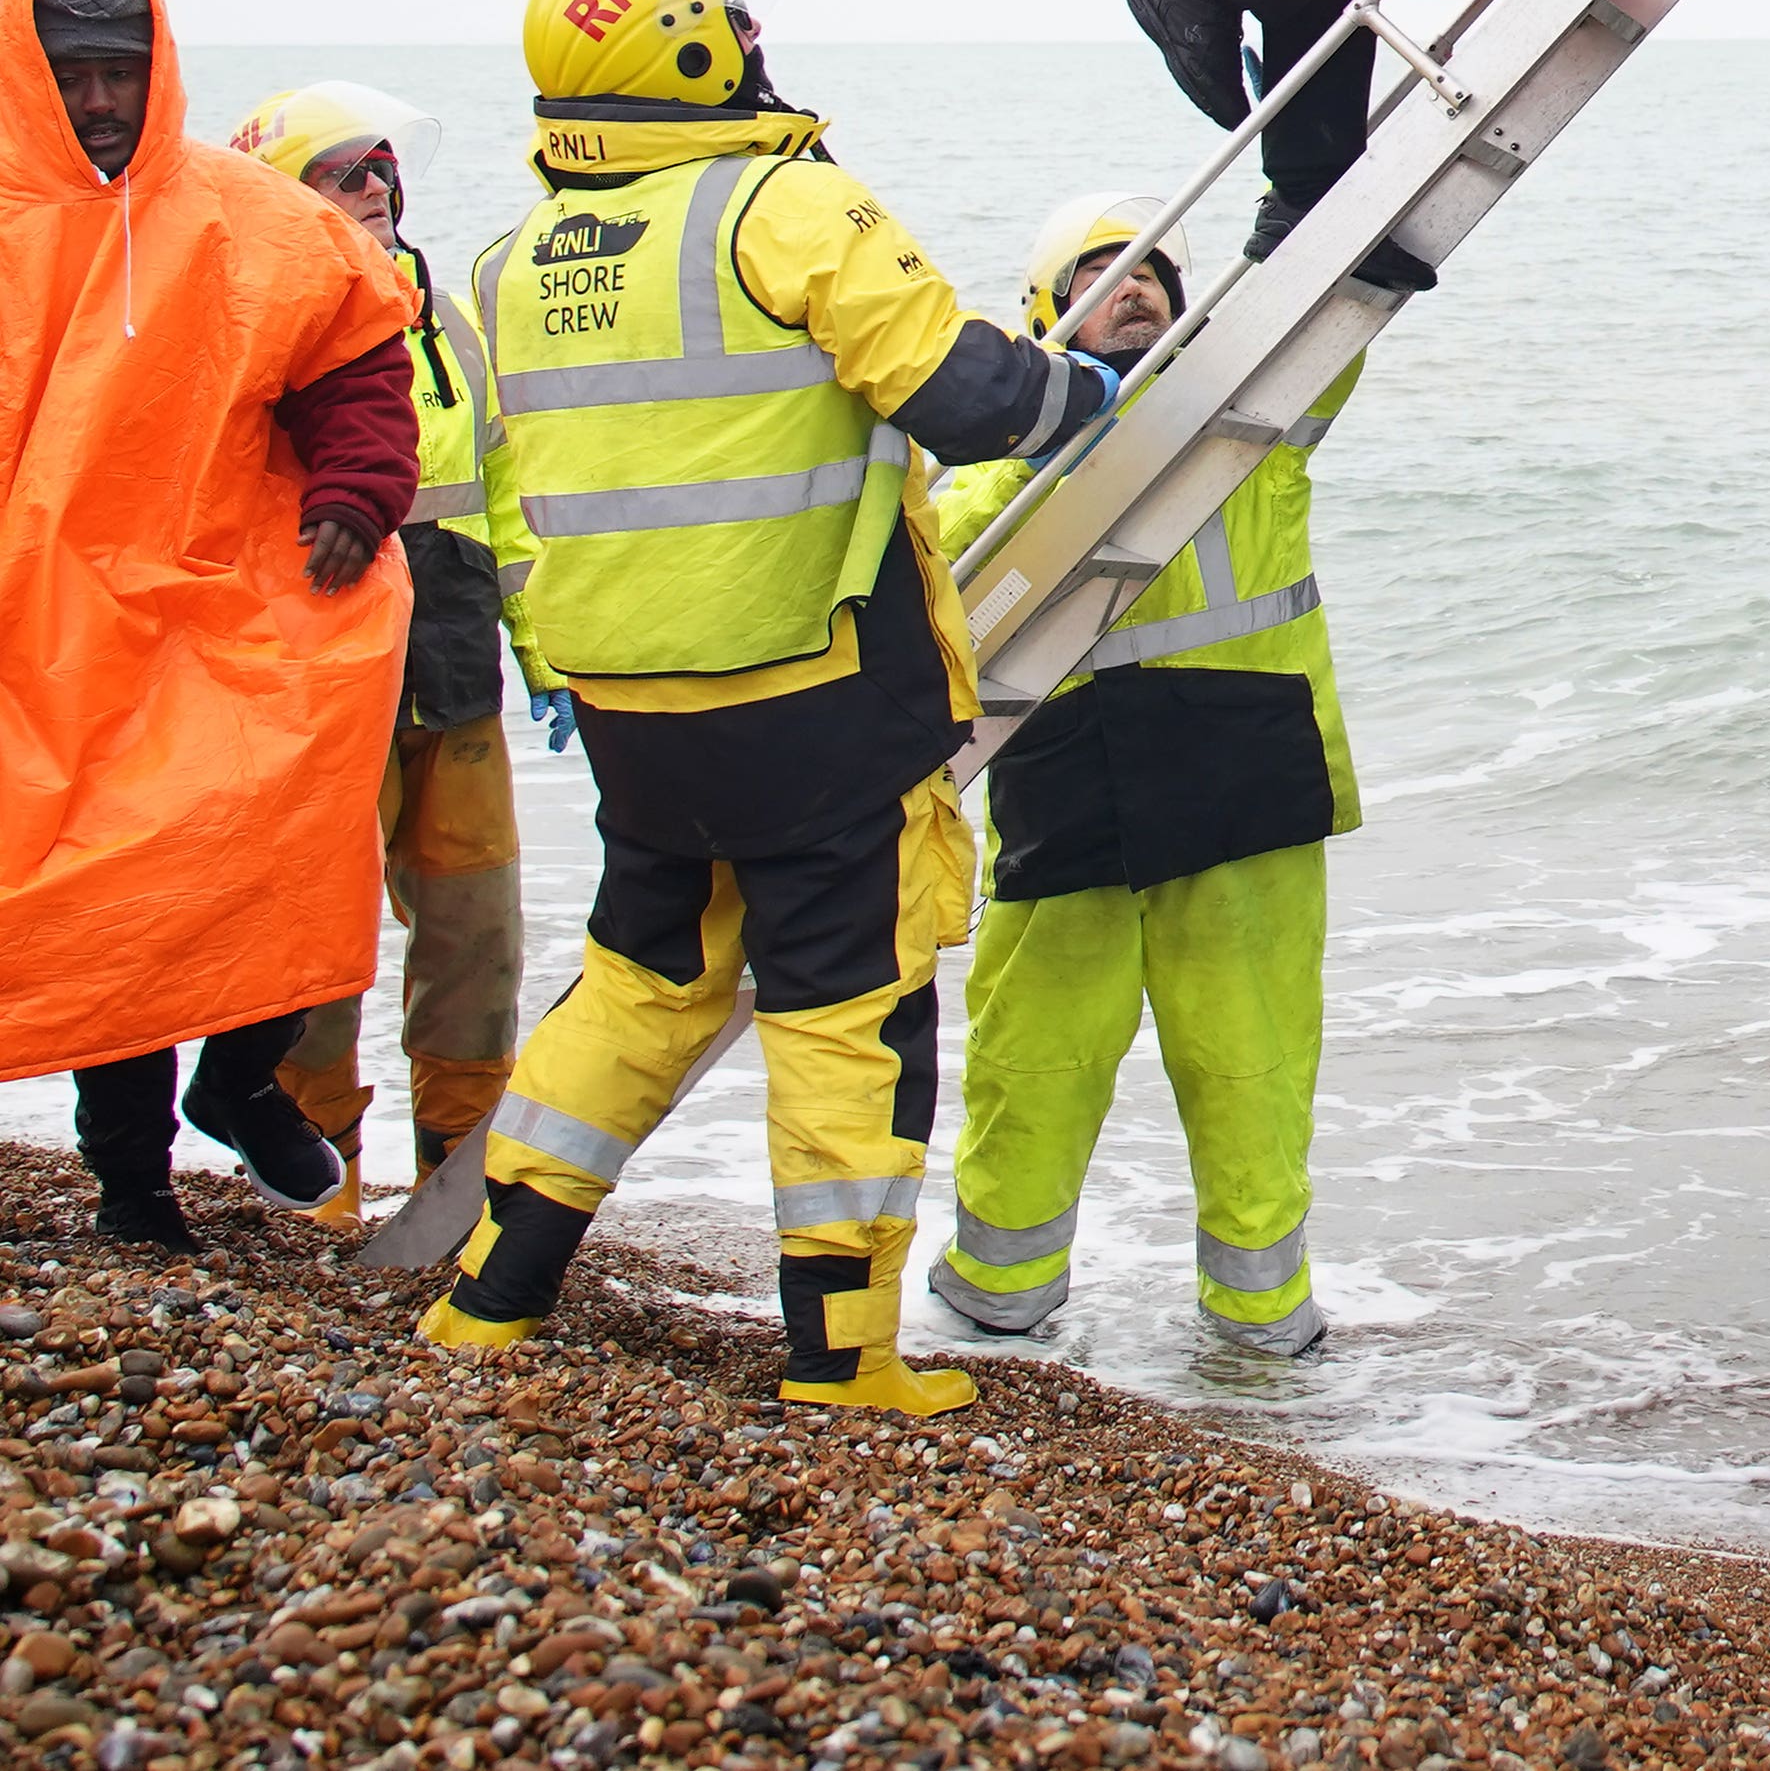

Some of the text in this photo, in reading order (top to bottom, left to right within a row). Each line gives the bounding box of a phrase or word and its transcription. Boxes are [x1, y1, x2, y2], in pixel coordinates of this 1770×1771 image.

[229, 110, 285, 153] NLI
[549, 131, 606, 161] RNLI
[551, 226, 602, 258] RNLI
[539, 263, 626, 300] SHORE
[544, 301, 619, 336] CREW
[422, 387, 465, 408] RNI
